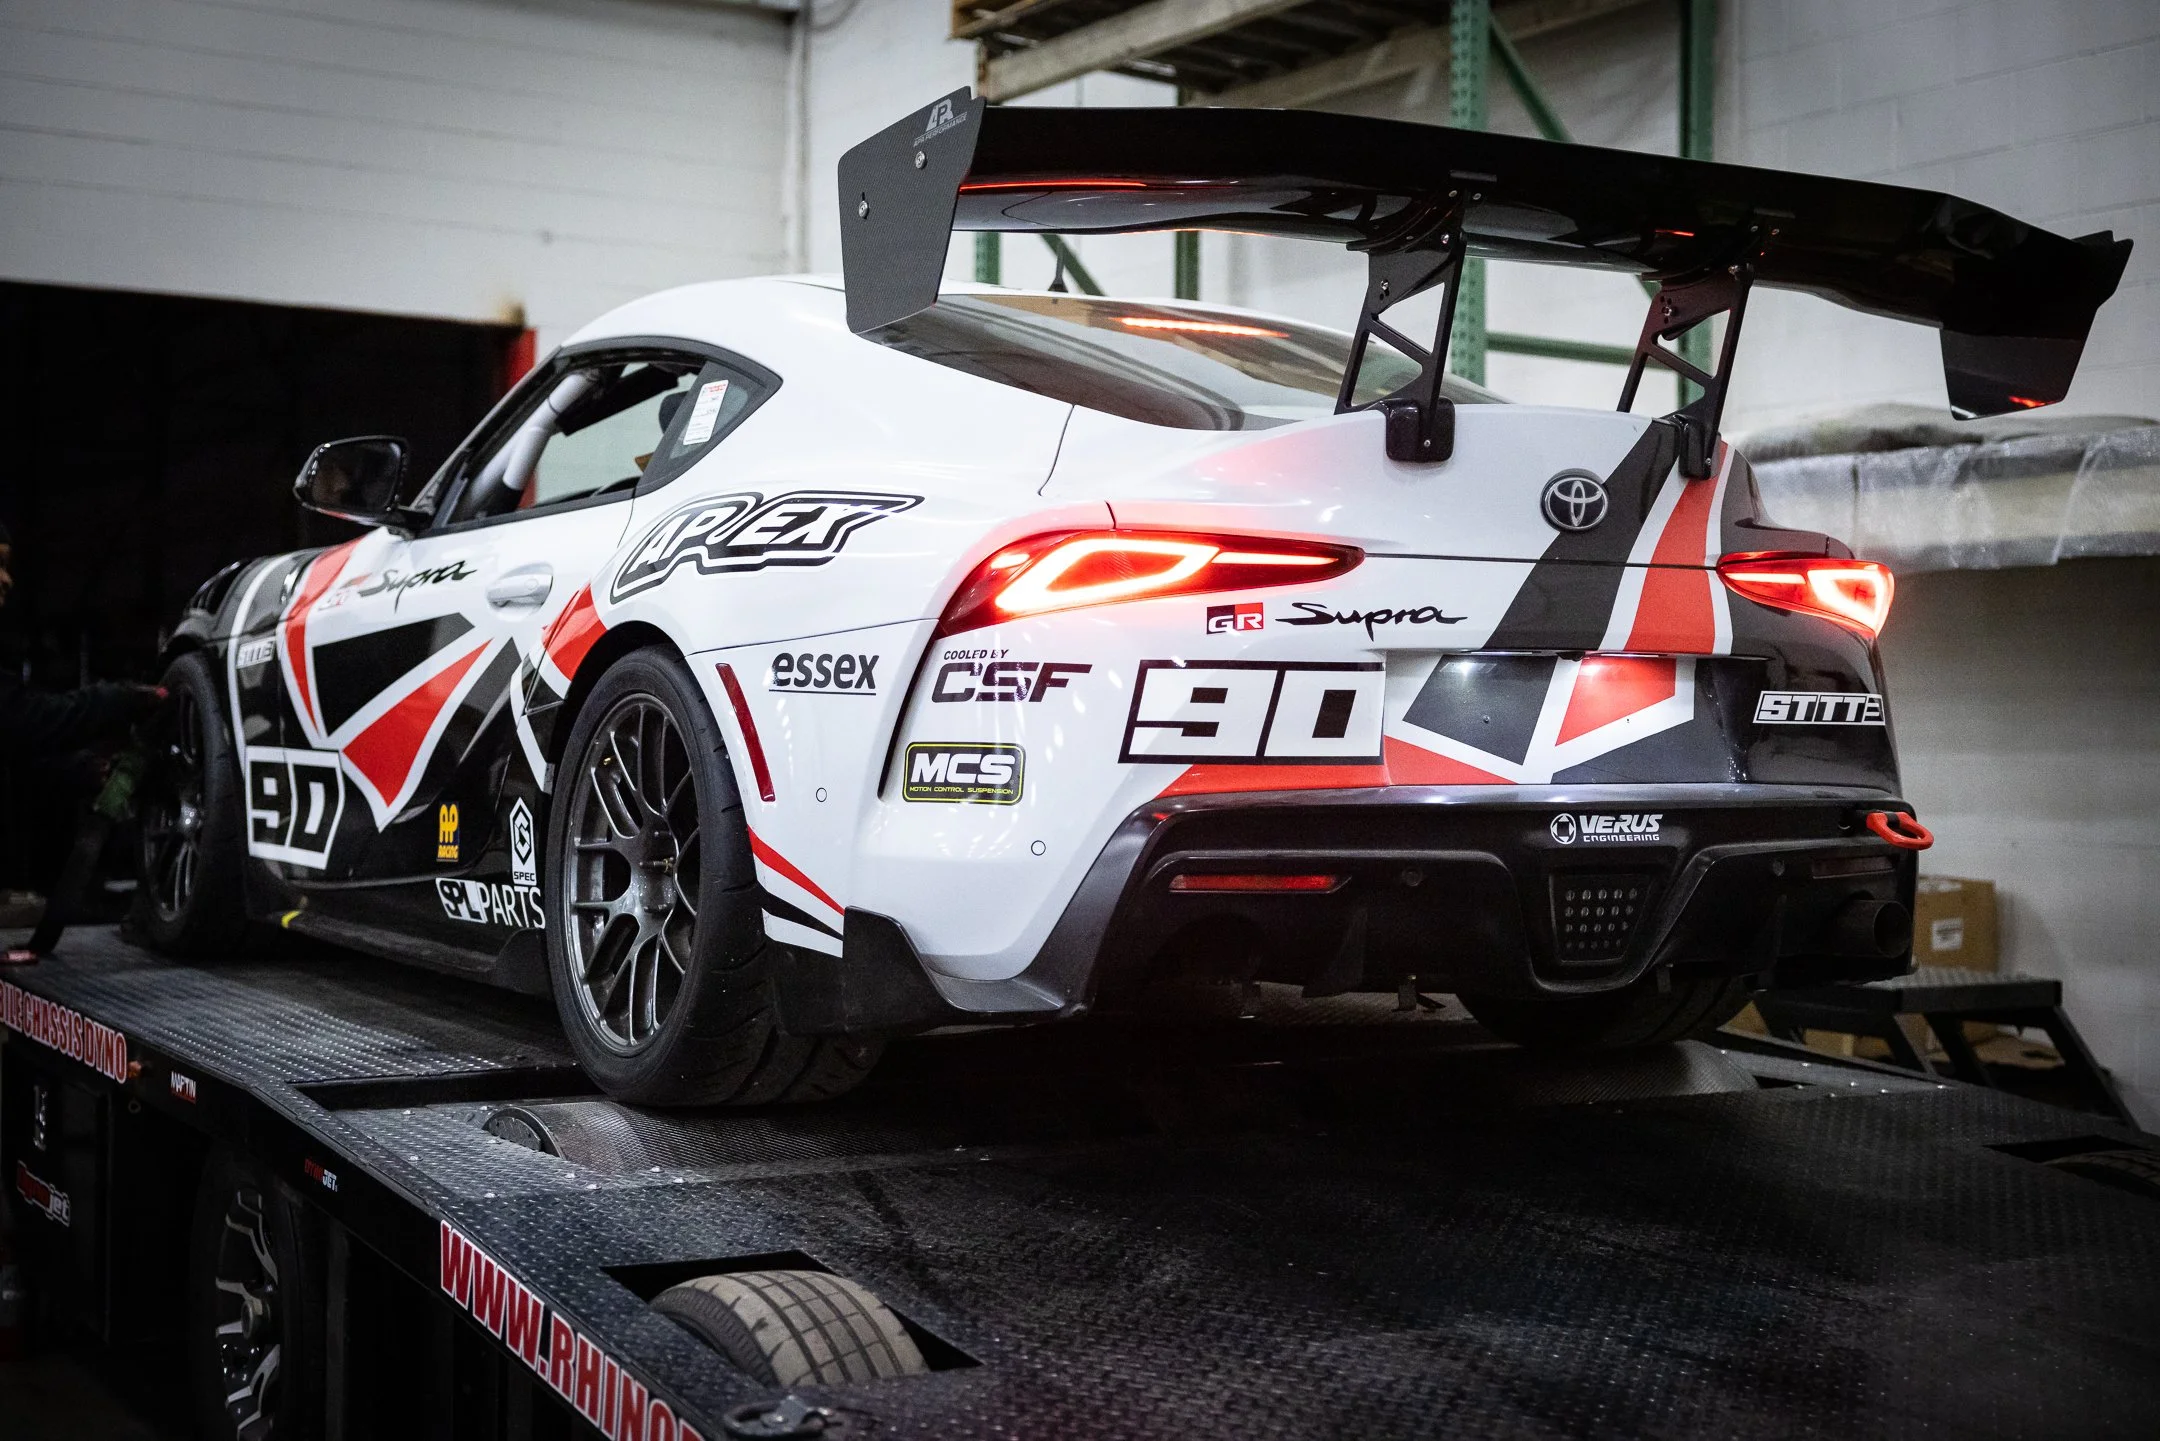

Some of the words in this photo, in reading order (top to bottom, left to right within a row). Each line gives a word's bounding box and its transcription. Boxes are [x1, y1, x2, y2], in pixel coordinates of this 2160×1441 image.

[357, 560, 479, 613] Supra
[1207, 608, 1264, 635] GR
[1275, 602, 1469, 642] Supra
[771, 652, 880, 691] essex
[944, 650, 988, 661] COOLED
[990, 649, 1009, 659] BY
[932, 662, 1093, 702] CSF
[1122, 664, 1386, 760] 90
[910, 752, 1016, 785] MCS
[249, 759, 342, 856] 90
[967, 787, 1013, 795] SUSPENSION
[439, 804, 459, 844] AP
[1579, 814, 1663, 834] VERUS
[1583, 834, 1660, 842] ENGINEERING
[513, 871, 535, 882] SPEC
[476, 881, 546, 929] PARTS
[24, 991, 83, 1061] CHASSIS
[84, 1017, 127, 1084] DYNO
